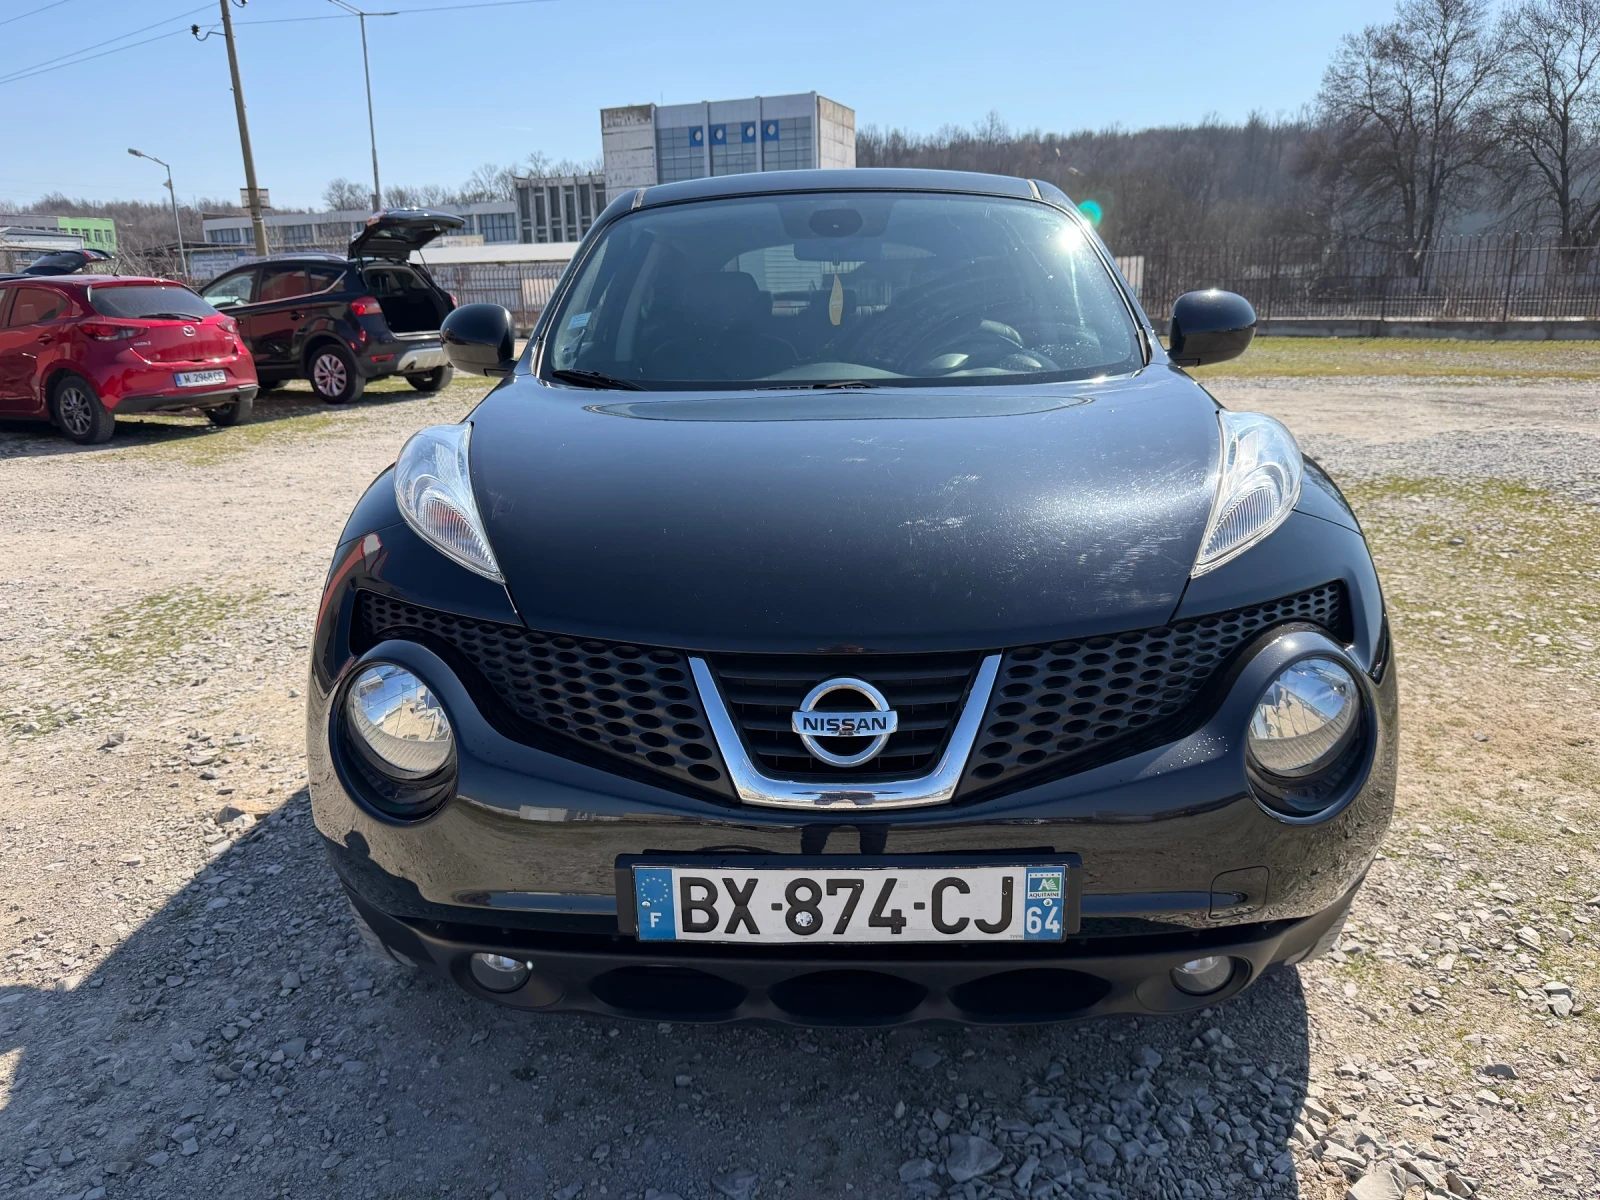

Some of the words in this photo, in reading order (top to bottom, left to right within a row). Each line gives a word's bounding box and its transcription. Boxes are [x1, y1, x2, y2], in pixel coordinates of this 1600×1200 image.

[803, 717, 886, 731] NISSAN
[650, 912, 662, 928] F
[1026, 906, 1060, 934] 64
